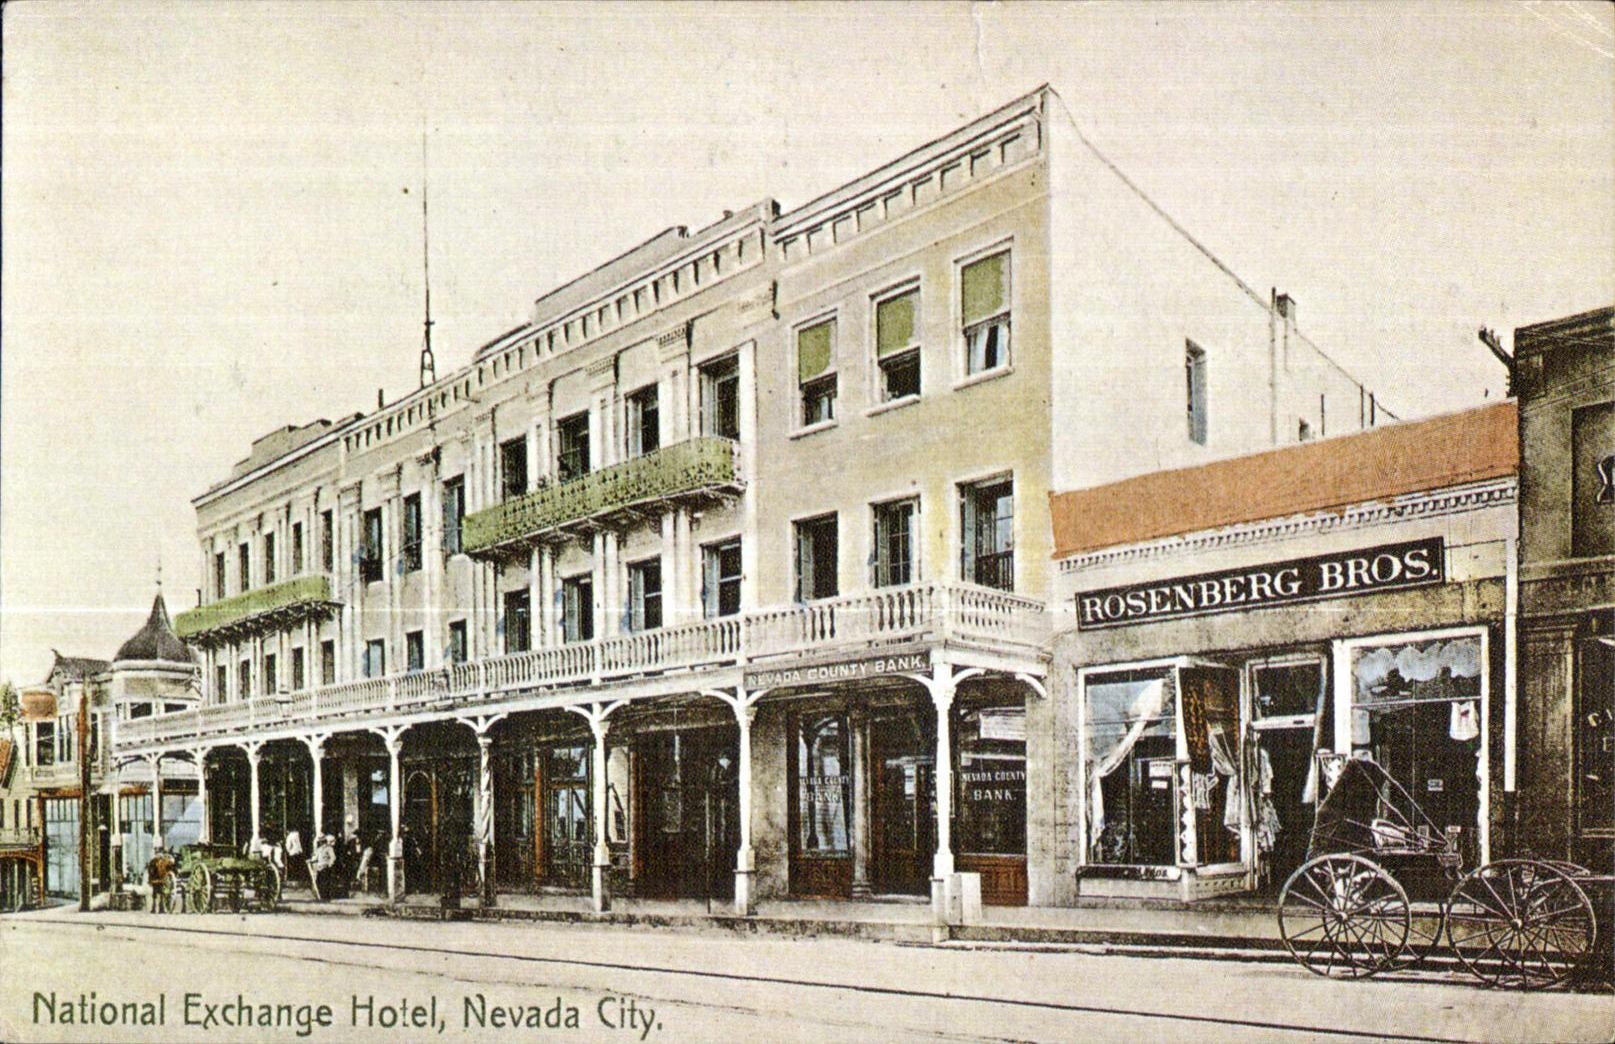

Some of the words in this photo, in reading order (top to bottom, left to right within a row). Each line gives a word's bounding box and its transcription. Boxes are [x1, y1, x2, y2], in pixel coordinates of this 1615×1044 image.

[1083, 568, 1302, 622] ROSENBERG
[1319, 550, 1438, 592] BROS.
[747, 671, 801, 687] NEVADA
[807, 663, 868, 680] COUNTY
[875, 655, 926, 672] BANK.
[961, 772, 992, 782] NEVADA
[994, 771, 1025, 781] COUNTY
